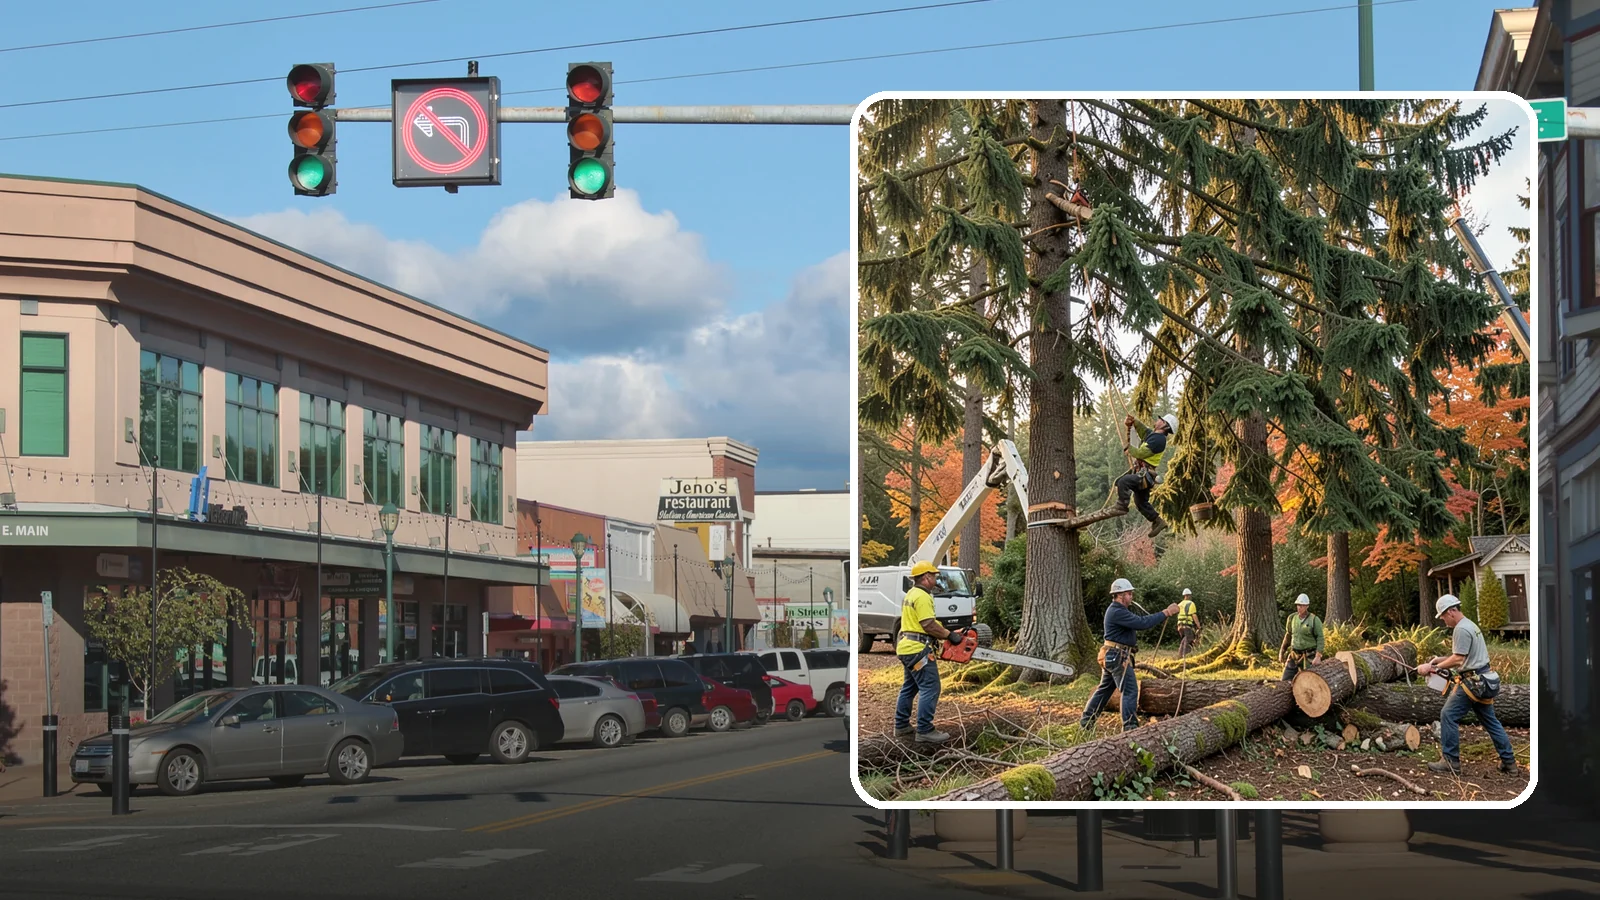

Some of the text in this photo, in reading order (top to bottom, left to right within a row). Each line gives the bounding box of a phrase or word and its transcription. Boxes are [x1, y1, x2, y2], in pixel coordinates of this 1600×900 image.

[669, 480, 727, 494] Jeno's
[665, 496, 731, 509] restaurant
[658, 510, 682, 520] Italian
[686, 510, 715, 519] American
[715, 509, 738, 519] Cuisine
[2, 525, 49, 536] E. MAIN
[797, 607, 828, 617] Street
[790, 619, 824, 627] lass
